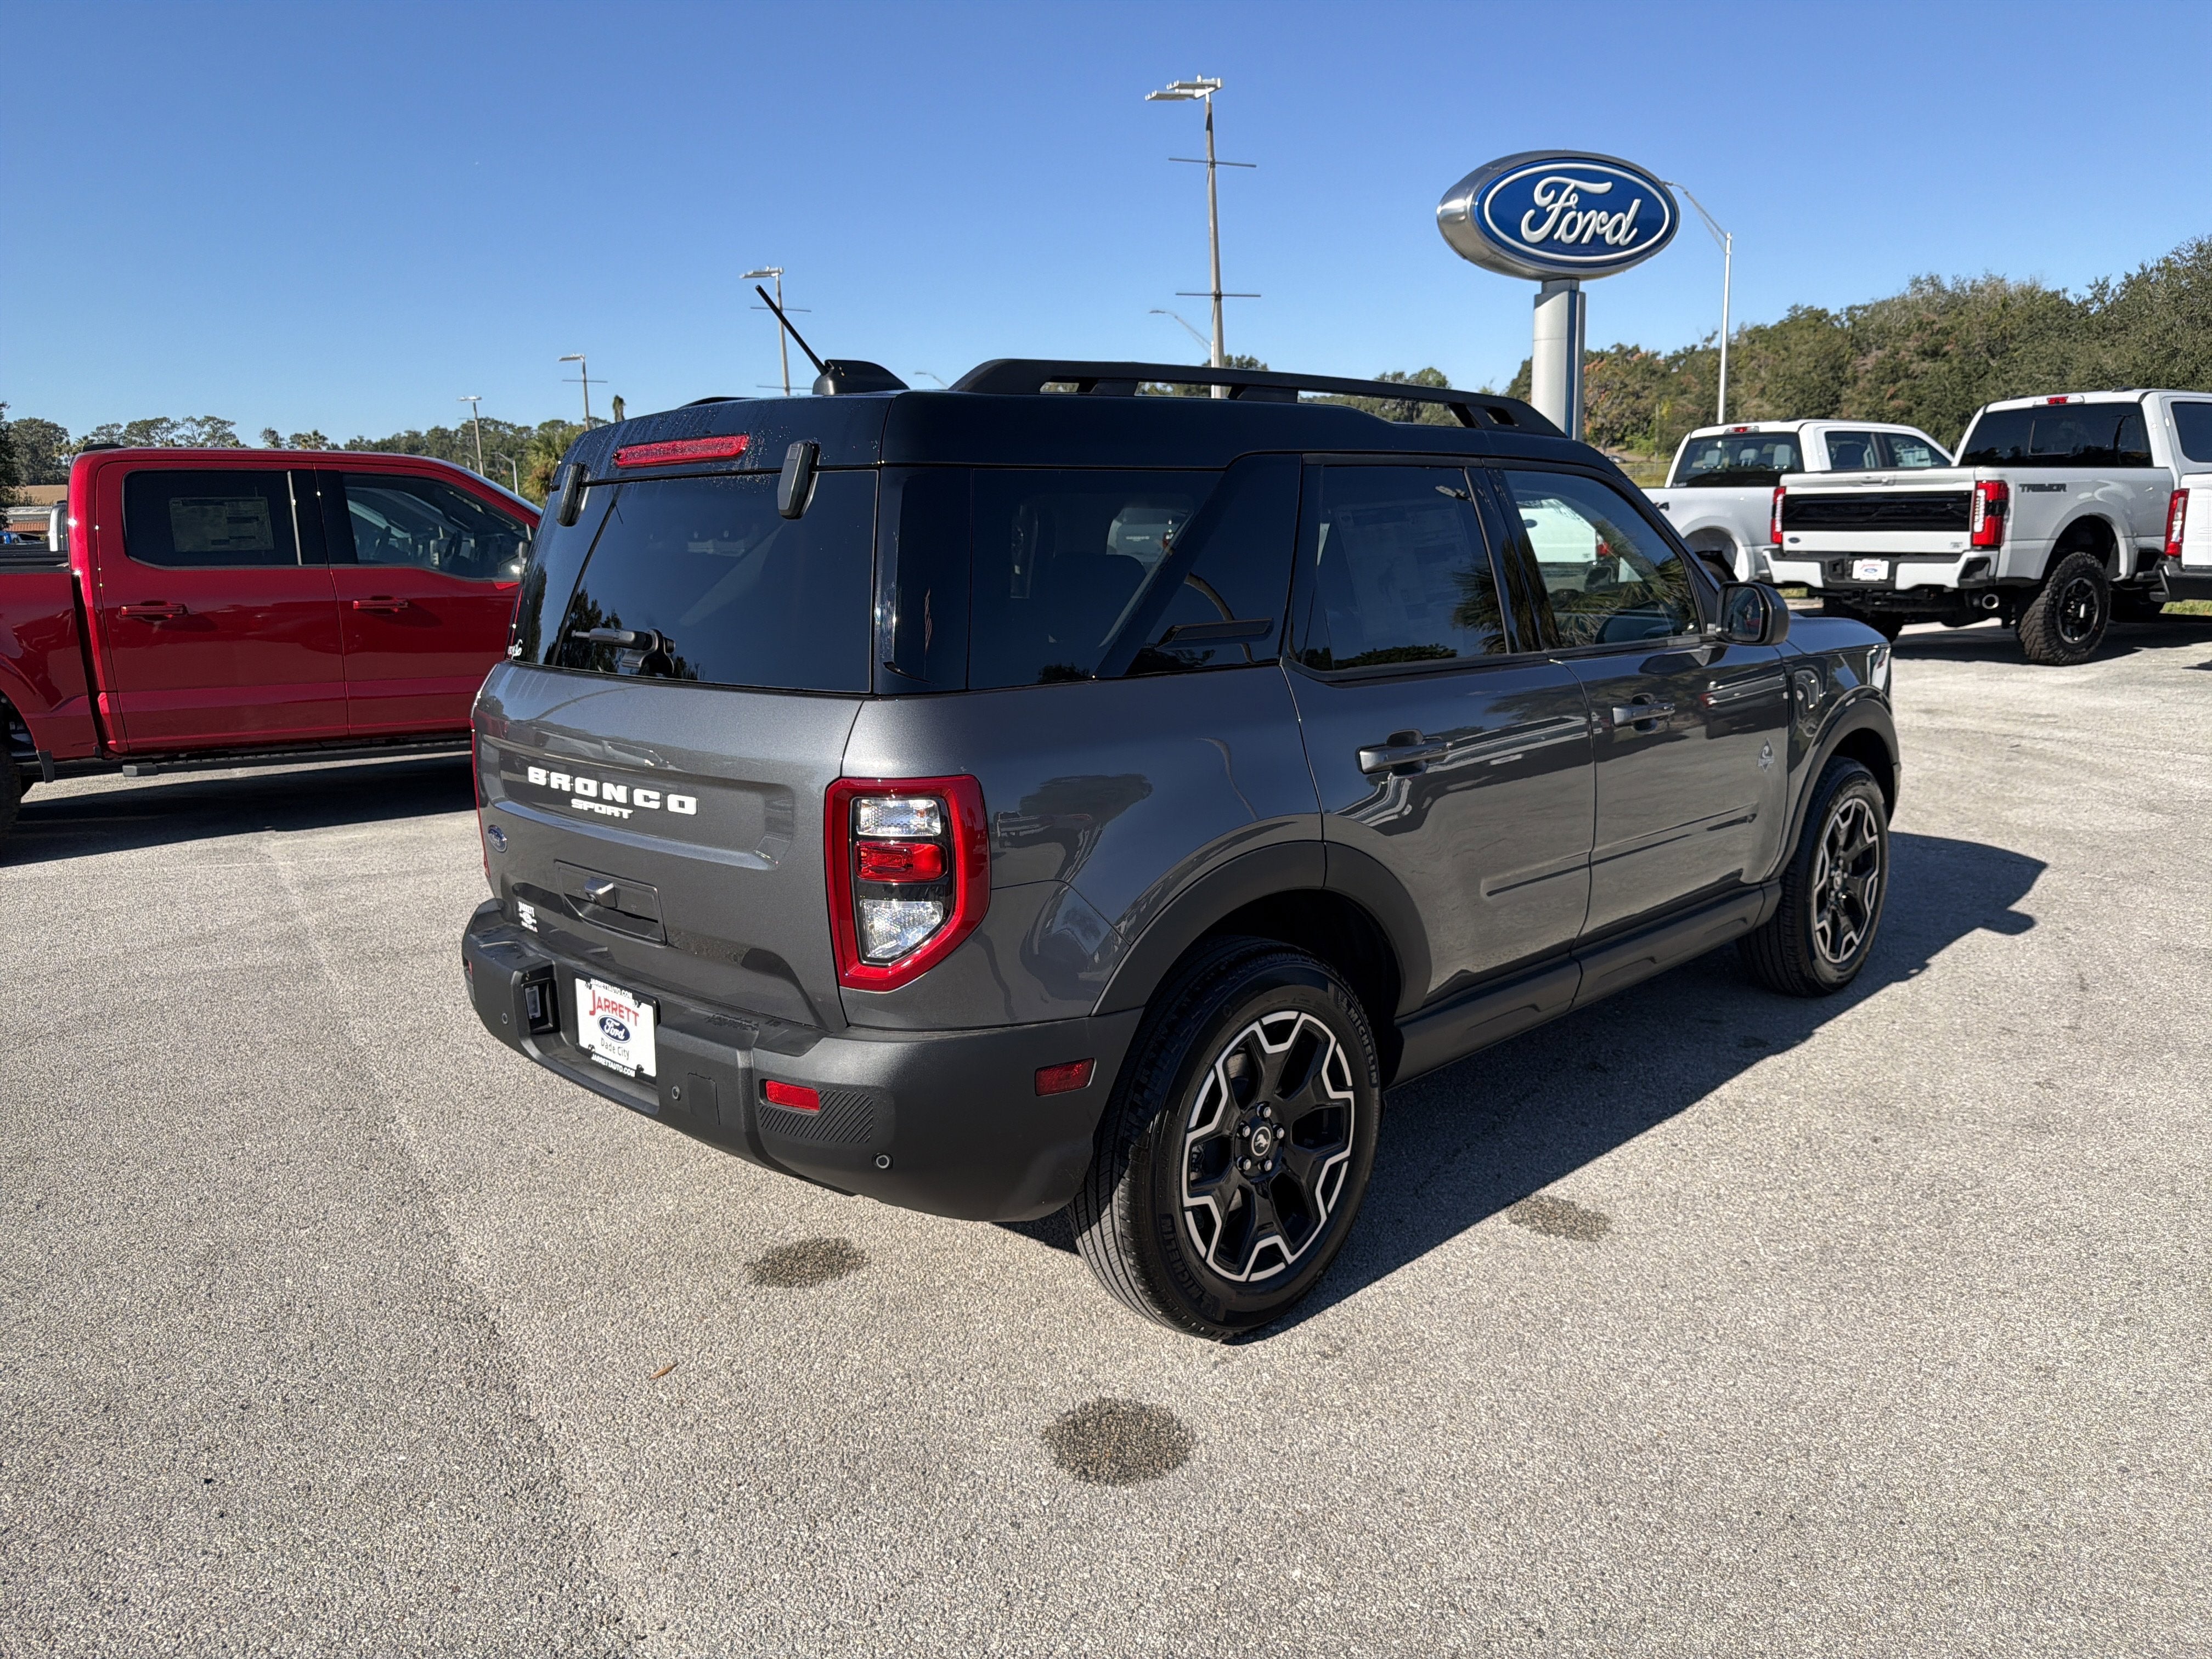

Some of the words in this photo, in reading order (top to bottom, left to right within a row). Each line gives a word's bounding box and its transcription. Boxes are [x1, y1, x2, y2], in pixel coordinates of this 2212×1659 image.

[1521, 176, 1641, 246] Ford
[528, 766, 697, 815] BRONCO
[571, 798, 634, 819] SPORT
[589, 989, 640, 1026] JARRETT
[604, 1018, 625, 1040] Ford
[1347, 1007, 1378, 1085] MICHELIN
[591, 1053, 635, 1077] JARRETTAUTO.COM
[601, 1037, 616, 1054] Dade
[617, 1046, 629, 1061] City
[1160, 1218, 1203, 1300] MICHELIN
